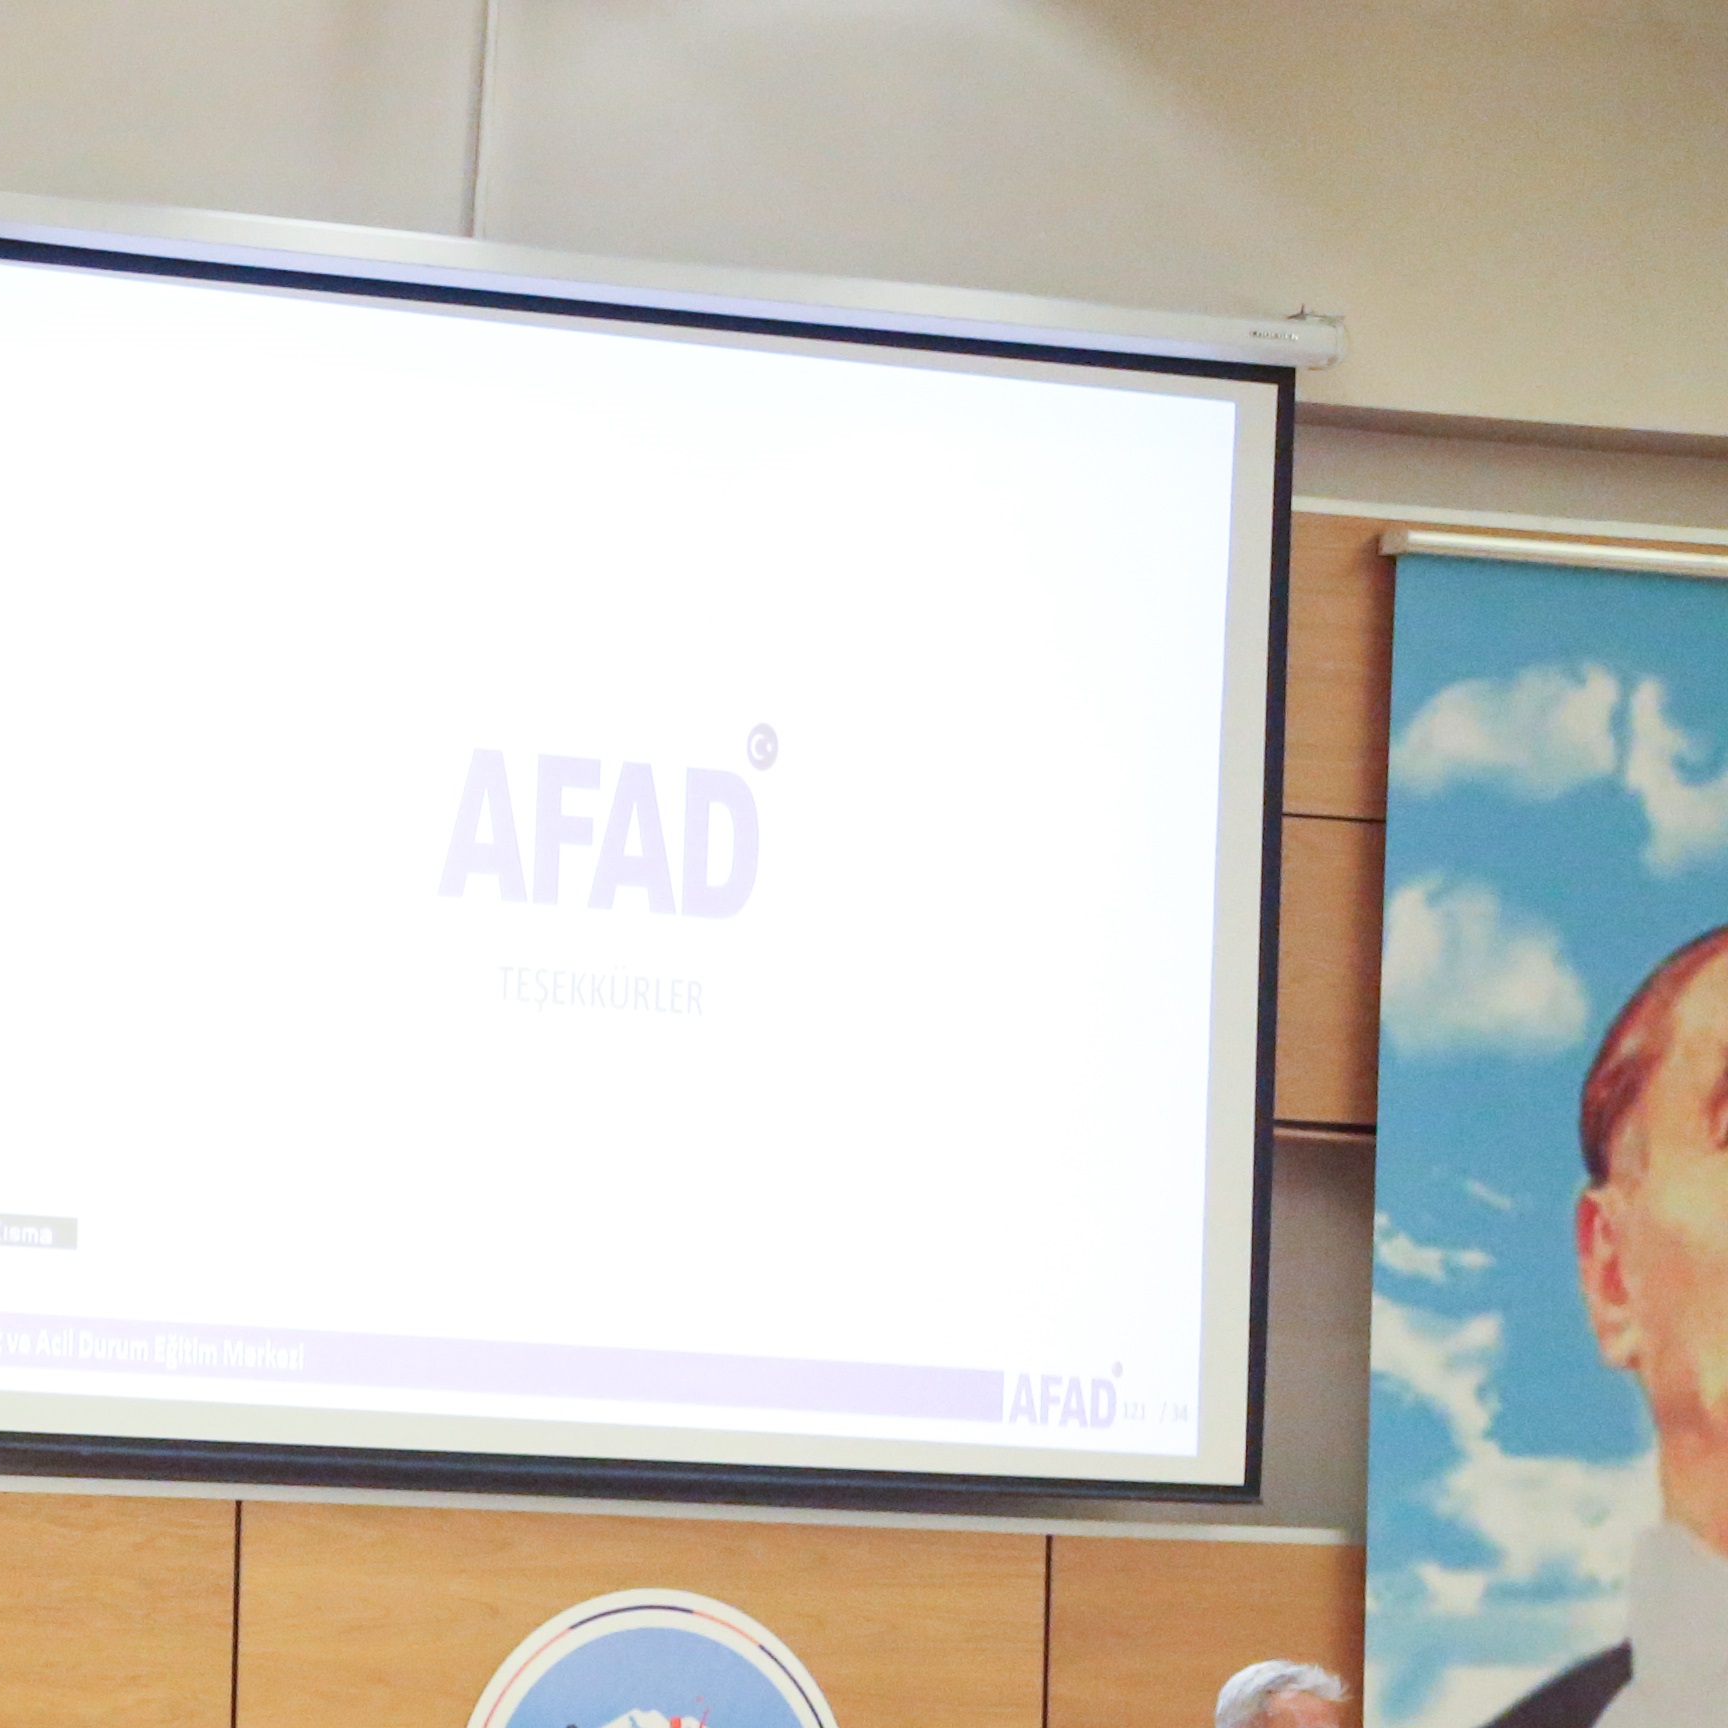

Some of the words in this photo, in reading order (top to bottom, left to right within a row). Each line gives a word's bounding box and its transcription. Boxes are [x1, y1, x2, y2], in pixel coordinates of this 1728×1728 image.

[437, 748, 760, 919] AFAD
[497, 964, 703, 1017] TEŞEKKÜRLER
[79, 1331, 149, 1362] Durum
[1009, 1372, 1117, 1429] AFAD
